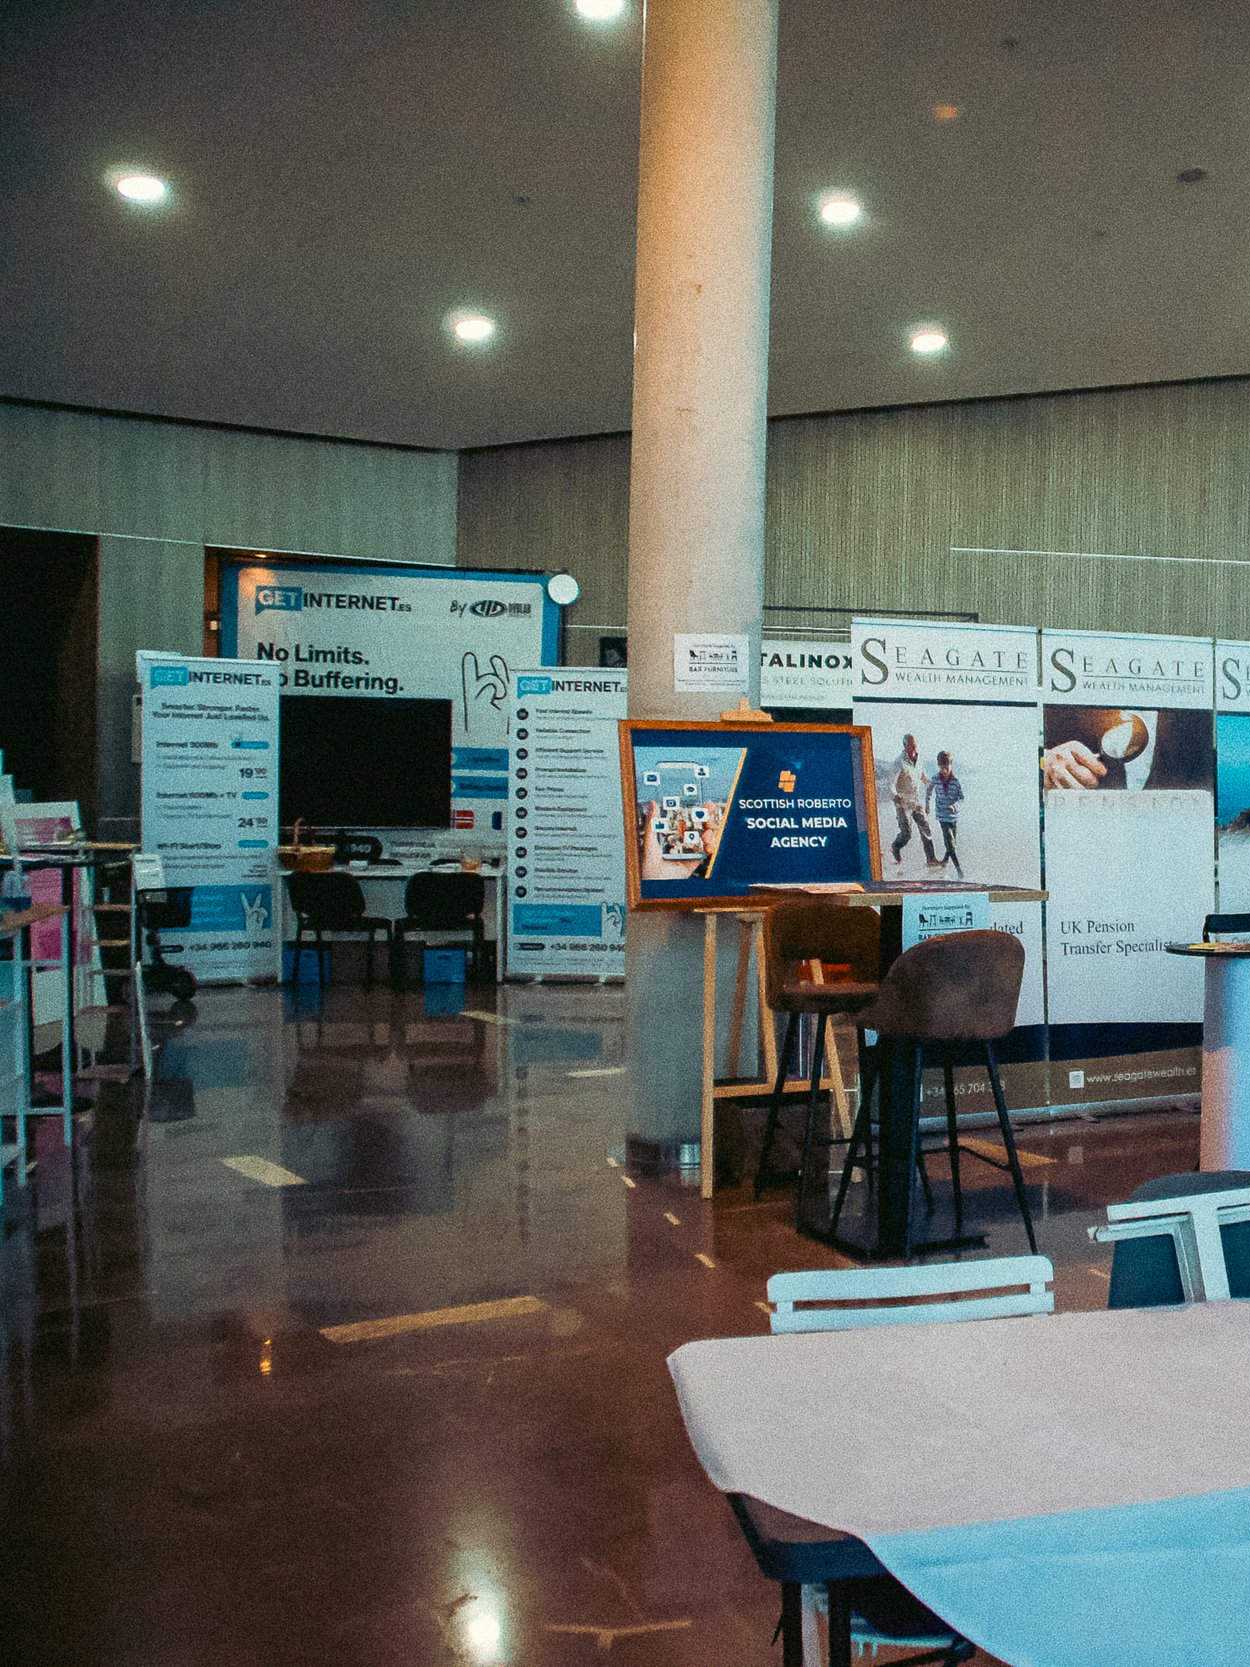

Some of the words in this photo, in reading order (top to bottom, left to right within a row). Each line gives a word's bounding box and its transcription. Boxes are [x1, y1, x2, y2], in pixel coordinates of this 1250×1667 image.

[258, 590, 297, 607] GET
[450, 600, 466, 618] By
[257, 642, 288, 661] No
[294, 644, 369, 666] Limits.
[861, 638, 1028, 686] SEAGATE
[1050, 648, 1205, 693] SEAGATE
[294, 669, 404, 694] Buffering.
[895, 671, 941, 683] WEALTH
[946, 673, 1029, 687] MANAGEMENT
[1083, 680, 1125, 691] WEALTH
[1129, 682, 1205, 694] MANAGEMENT
[739, 799, 795, 809] SCOTTISH
[797, 798, 852, 809] ROBERTO
[747, 817, 799, 829] SOCIAL
[801, 817, 848, 828] MEDIA
[770, 836, 827, 848] AGENCY
[990, 921, 1024, 935] lated
[1060, 921, 1082, 934] UK
[1087, 919, 1135, 933] Pension
[1061, 941, 1112, 956] Transfer
